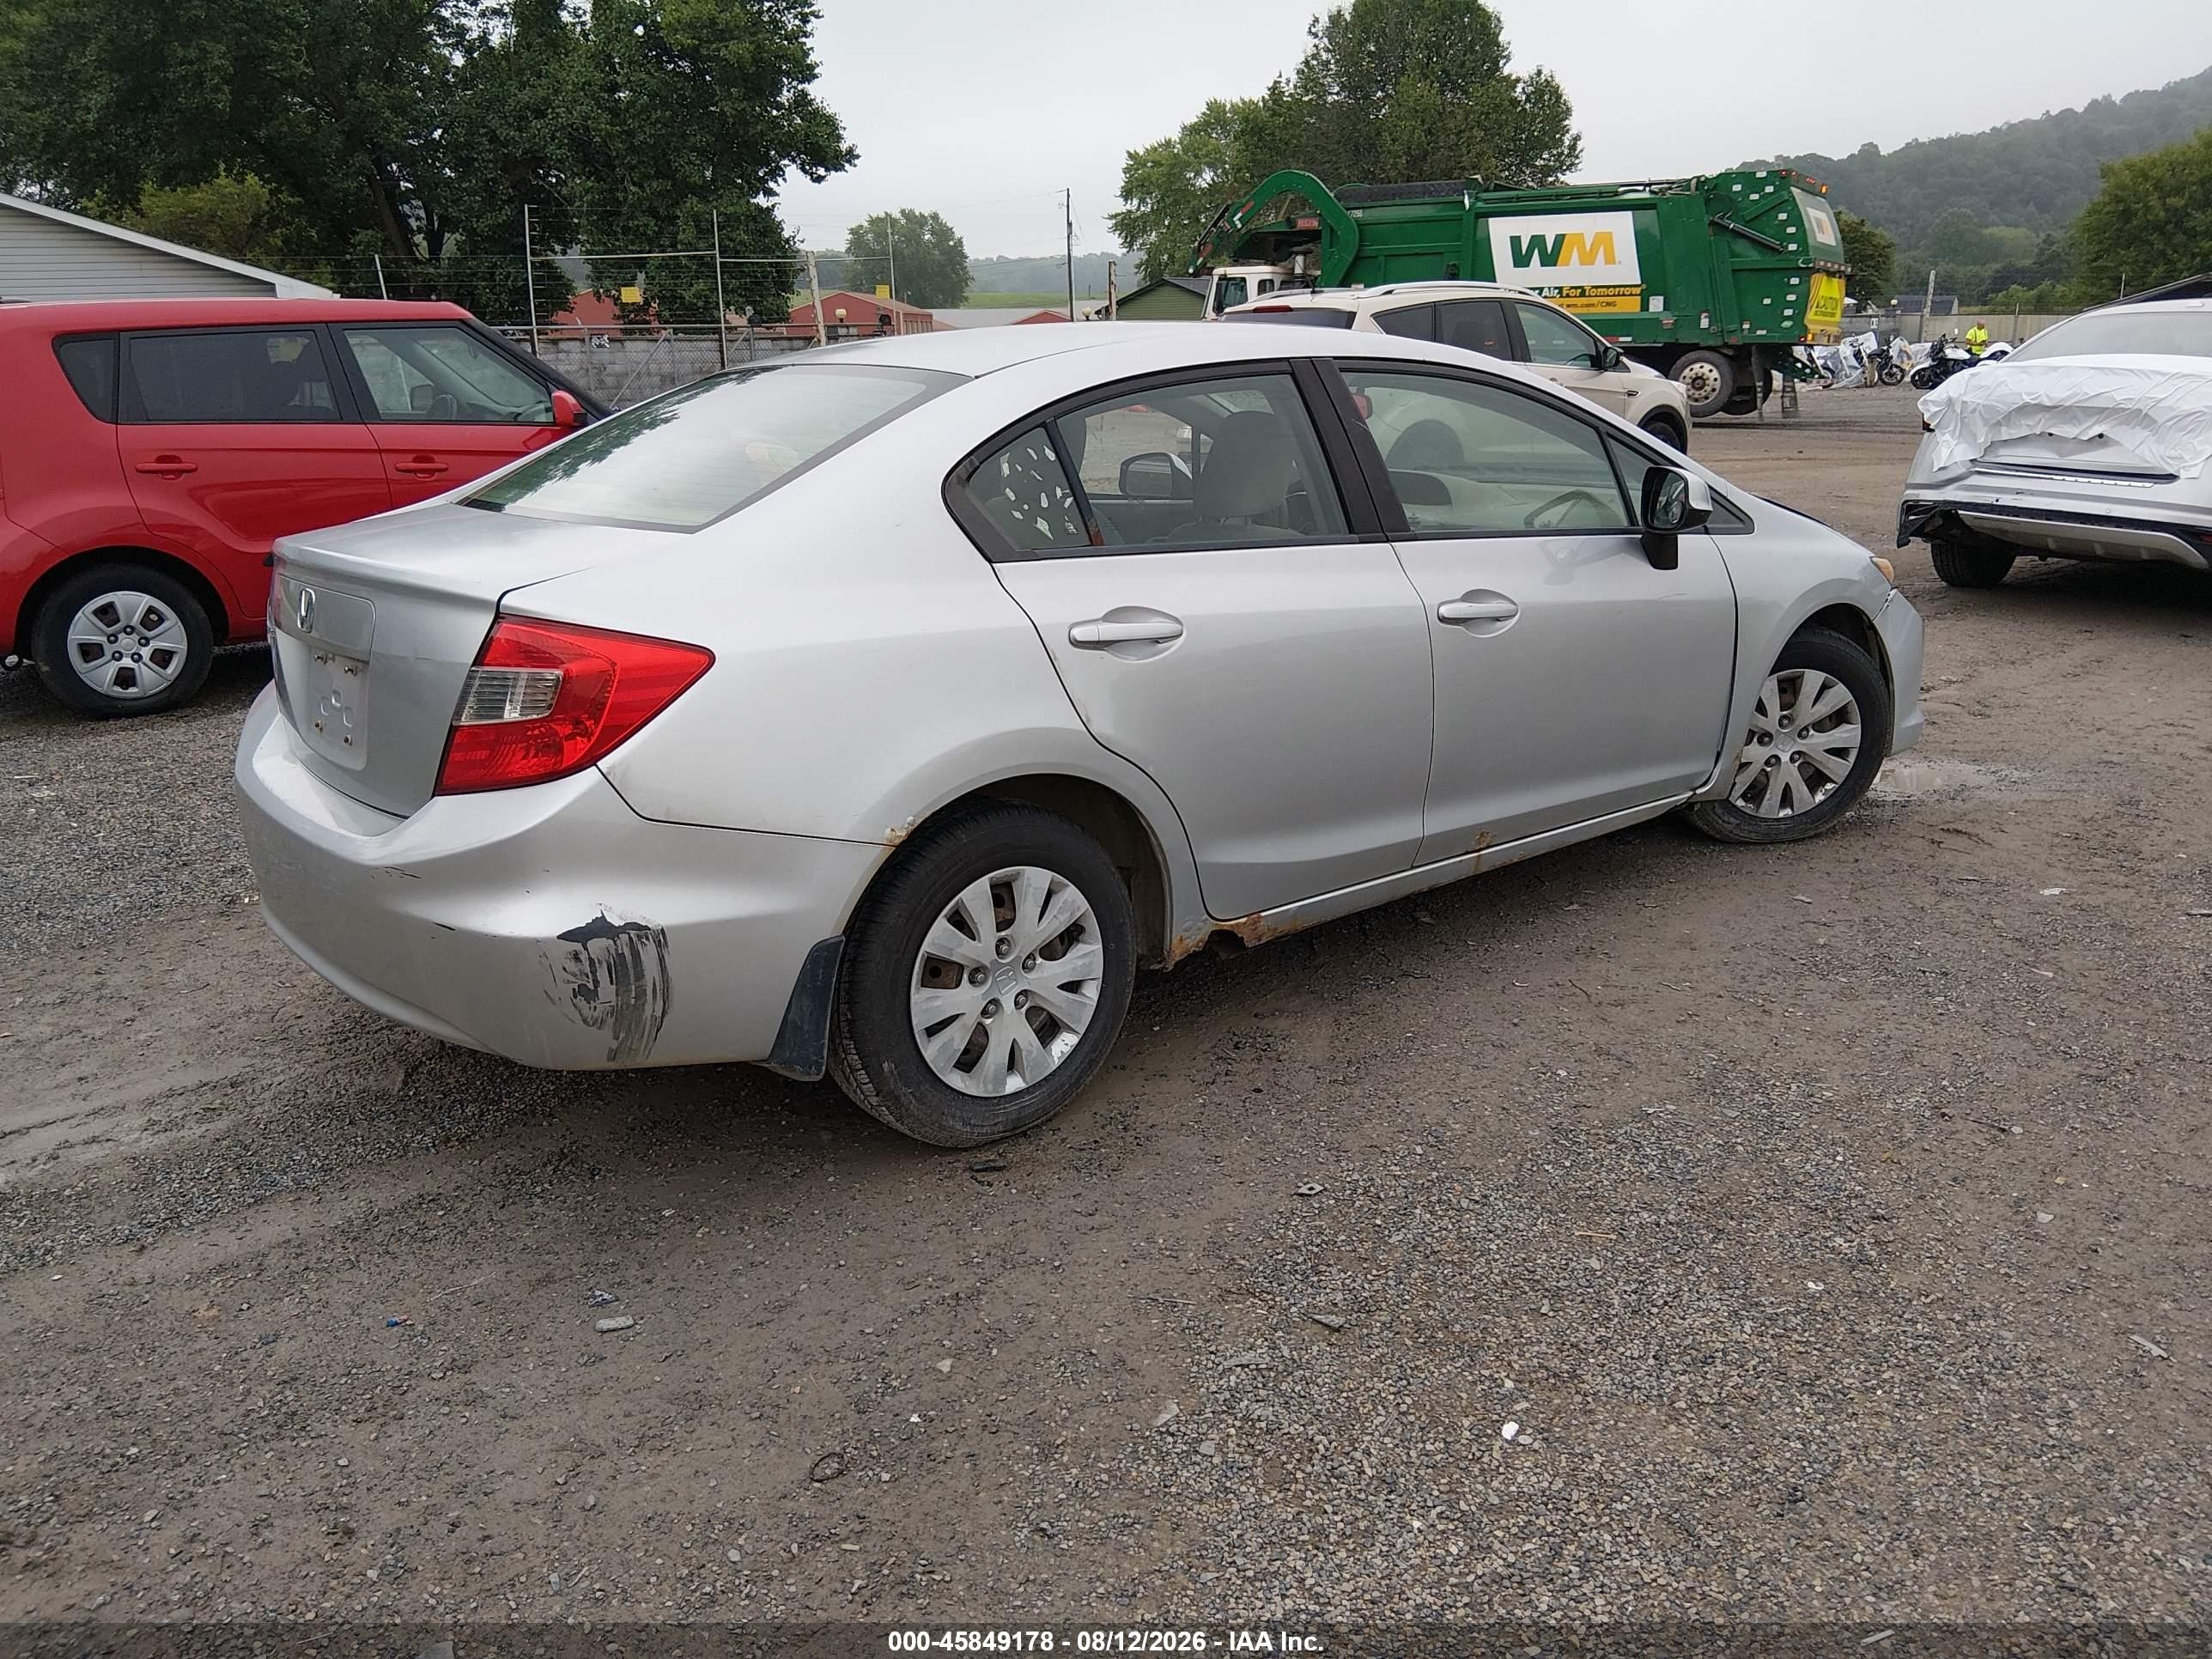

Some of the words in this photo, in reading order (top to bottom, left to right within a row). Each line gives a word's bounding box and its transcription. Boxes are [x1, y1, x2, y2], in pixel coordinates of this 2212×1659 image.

[1509, 231, 1617, 268] WM
[1541, 287, 1560, 299] Air,
[1562, 287, 1582, 297] For
[1583, 285, 1642, 296] Tomorrow
